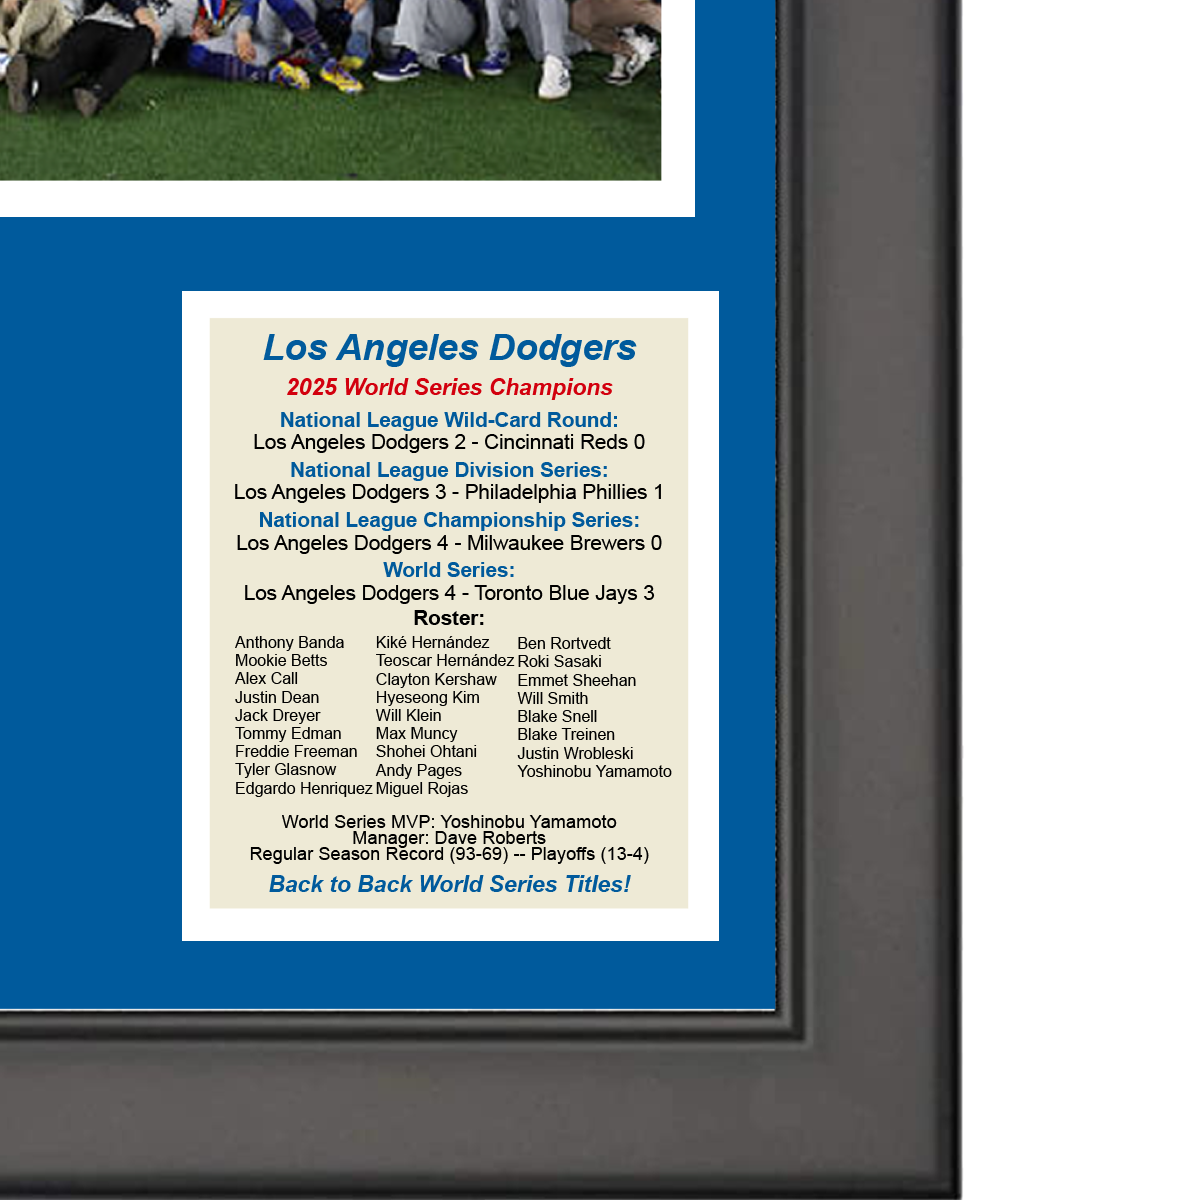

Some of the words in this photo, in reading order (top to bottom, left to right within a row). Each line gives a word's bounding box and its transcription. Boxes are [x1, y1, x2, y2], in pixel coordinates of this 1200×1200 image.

[262, 333, 328, 361] Los
[335, 333, 479, 368] Angeles
[488, 333, 637, 368] Dodgers
[286, 377, 338, 396] 2025
[345, 377, 410, 396] World
[414, 377, 483, 396] Series
[490, 377, 613, 401] Champions
[280, 411, 361, 428] National
[367, 411, 439, 432] League
[443, 411, 541, 428] Wild-Card
[547, 411, 618, 428] Round:
[253, 433, 287, 450] Los
[290, 433, 366, 454] Angeles
[371, 433, 450, 454] Dodgers
[454, 433, 466, 450] 2
[484, 433, 574, 450] Cincinnati
[580, 433, 629, 450] Reds
[633, 433, 646, 450] 0
[290, 461, 371, 478] National
[377, 461, 449, 482] League
[455, 461, 534, 478] Division
[540, 461, 608, 478] Series:
[234, 483, 268, 500] Los
[270, 483, 347, 504] Angeles
[352, 483, 430, 504] Dodgers
[435, 483, 447, 500] 3
[465, 483, 577, 504] Philadelphia
[583, 483, 648, 500] Phillies
[654, 483, 662, 500] 1
[259, 511, 340, 528] National
[346, 511, 418, 532] League
[423, 511, 566, 532] Championship
[571, 511, 639, 528] Series:
[236, 534, 270, 551] Los
[273, 534, 349, 555] Angeles
[354, 534, 432, 555] Dodgers
[436, 534, 449, 551] 4
[467, 534, 565, 551] Milwaukee
[570, 534, 646, 551] Brewers
[650, 534, 663, 551] 0
[382, 561, 441, 578] World
[446, 561, 515, 578] Series:
[244, 584, 278, 601] Los
[280, 584, 357, 605] Angeles
[362, 584, 440, 605] Dodgers
[444, 584, 457, 601] 4
[473, 584, 543, 601] Toronto
[549, 584, 590, 601] Blue
[595, 584, 638, 605] Jays
[643, 584, 655, 601] 3
[414, 609, 484, 626] Roster:
[234, 635, 295, 652] Anthony
[298, 635, 345, 649] Banda
[376, 635, 408, 649] Kiké
[412, 635, 490, 649] Hernández
[517, 636, 546, 650] Ben
[550, 636, 612, 650] Rortvedt
[235, 653, 287, 667] Mookie
[291, 653, 328, 667] Betts
[375, 653, 433, 667] Teoscar
[436, 653, 515, 667] Hernández
[517, 654, 550, 668] Roki
[553, 654, 602, 668] Sasaki
[234, 671, 267, 685] Alex
[270, 671, 298, 685] Call
[375, 672, 430, 689] Clayton
[434, 672, 498, 686] Kershaw
[517, 673, 569, 687] Emmet
[572, 673, 637, 687] Sheehan
[234, 690, 277, 704] Justin
[281, 690, 320, 704] Dean
[376, 690, 448, 707] Hyeseong
[452, 690, 480, 704] Kim
[517, 691, 544, 705] Will
[547, 691, 589, 705] Smith
[234, 708, 269, 722] Jack
[272, 708, 322, 725] Dreyer
[375, 708, 402, 722] Will
[406, 708, 442, 722] Klein
[517, 709, 558, 723] Blake
[561, 709, 598, 723] Snell
[234, 726, 287, 743] Tommy
[291, 726, 342, 740] Edman
[376, 726, 407, 740] Max
[410, 726, 458, 743] Muncy
[517, 727, 558, 741] Blake
[561, 727, 615, 741] Treinen
[235, 744, 290, 758] Freddie
[294, 744, 358, 758] Freeman
[375, 744, 426, 758] Shohei
[430, 744, 477, 758] Ohtani
[517, 746, 559, 760] Justin
[563, 746, 634, 760] Wrobleski
[234, 762, 271, 779] Tyler
[274, 762, 337, 776] Glasnow
[375, 763, 413, 780] Andy
[417, 763, 463, 780] Pages
[517, 764, 592, 778] Yoshinobu
[595, 764, 673, 778] Yamamoto
[235, 781, 296, 798] Edgardo
[300, 781, 374, 798] Henriquez
[376, 781, 423, 798] Miguel
[427, 781, 469, 798] Rojas
[281, 814, 329, 829] World
[334, 814, 386, 829] Series
[391, 814, 435, 829] MVP:
[440, 814, 525, 829] Yoshinobu
[529, 814, 617, 829] Yamamoto
[352, 830, 429, 848] Manager:
[435, 830, 478, 845] Dave
[482, 830, 547, 845] Roberts
[250, 846, 315, 865] Regular
[318, 846, 380, 861] Season
[386, 846, 444, 861] Record
[449, 846, 509, 865] (93-69)
[531, 846, 596, 865] Playoffs
[600, 846, 650, 865] (13-4)
[268, 874, 325, 893] Back
[330, 875, 352, 893] to
[357, 874, 414, 893] Back
[420, 874, 485, 893] World
[489, 874, 558, 893] Series
[565, 874, 632, 893] Titles!
